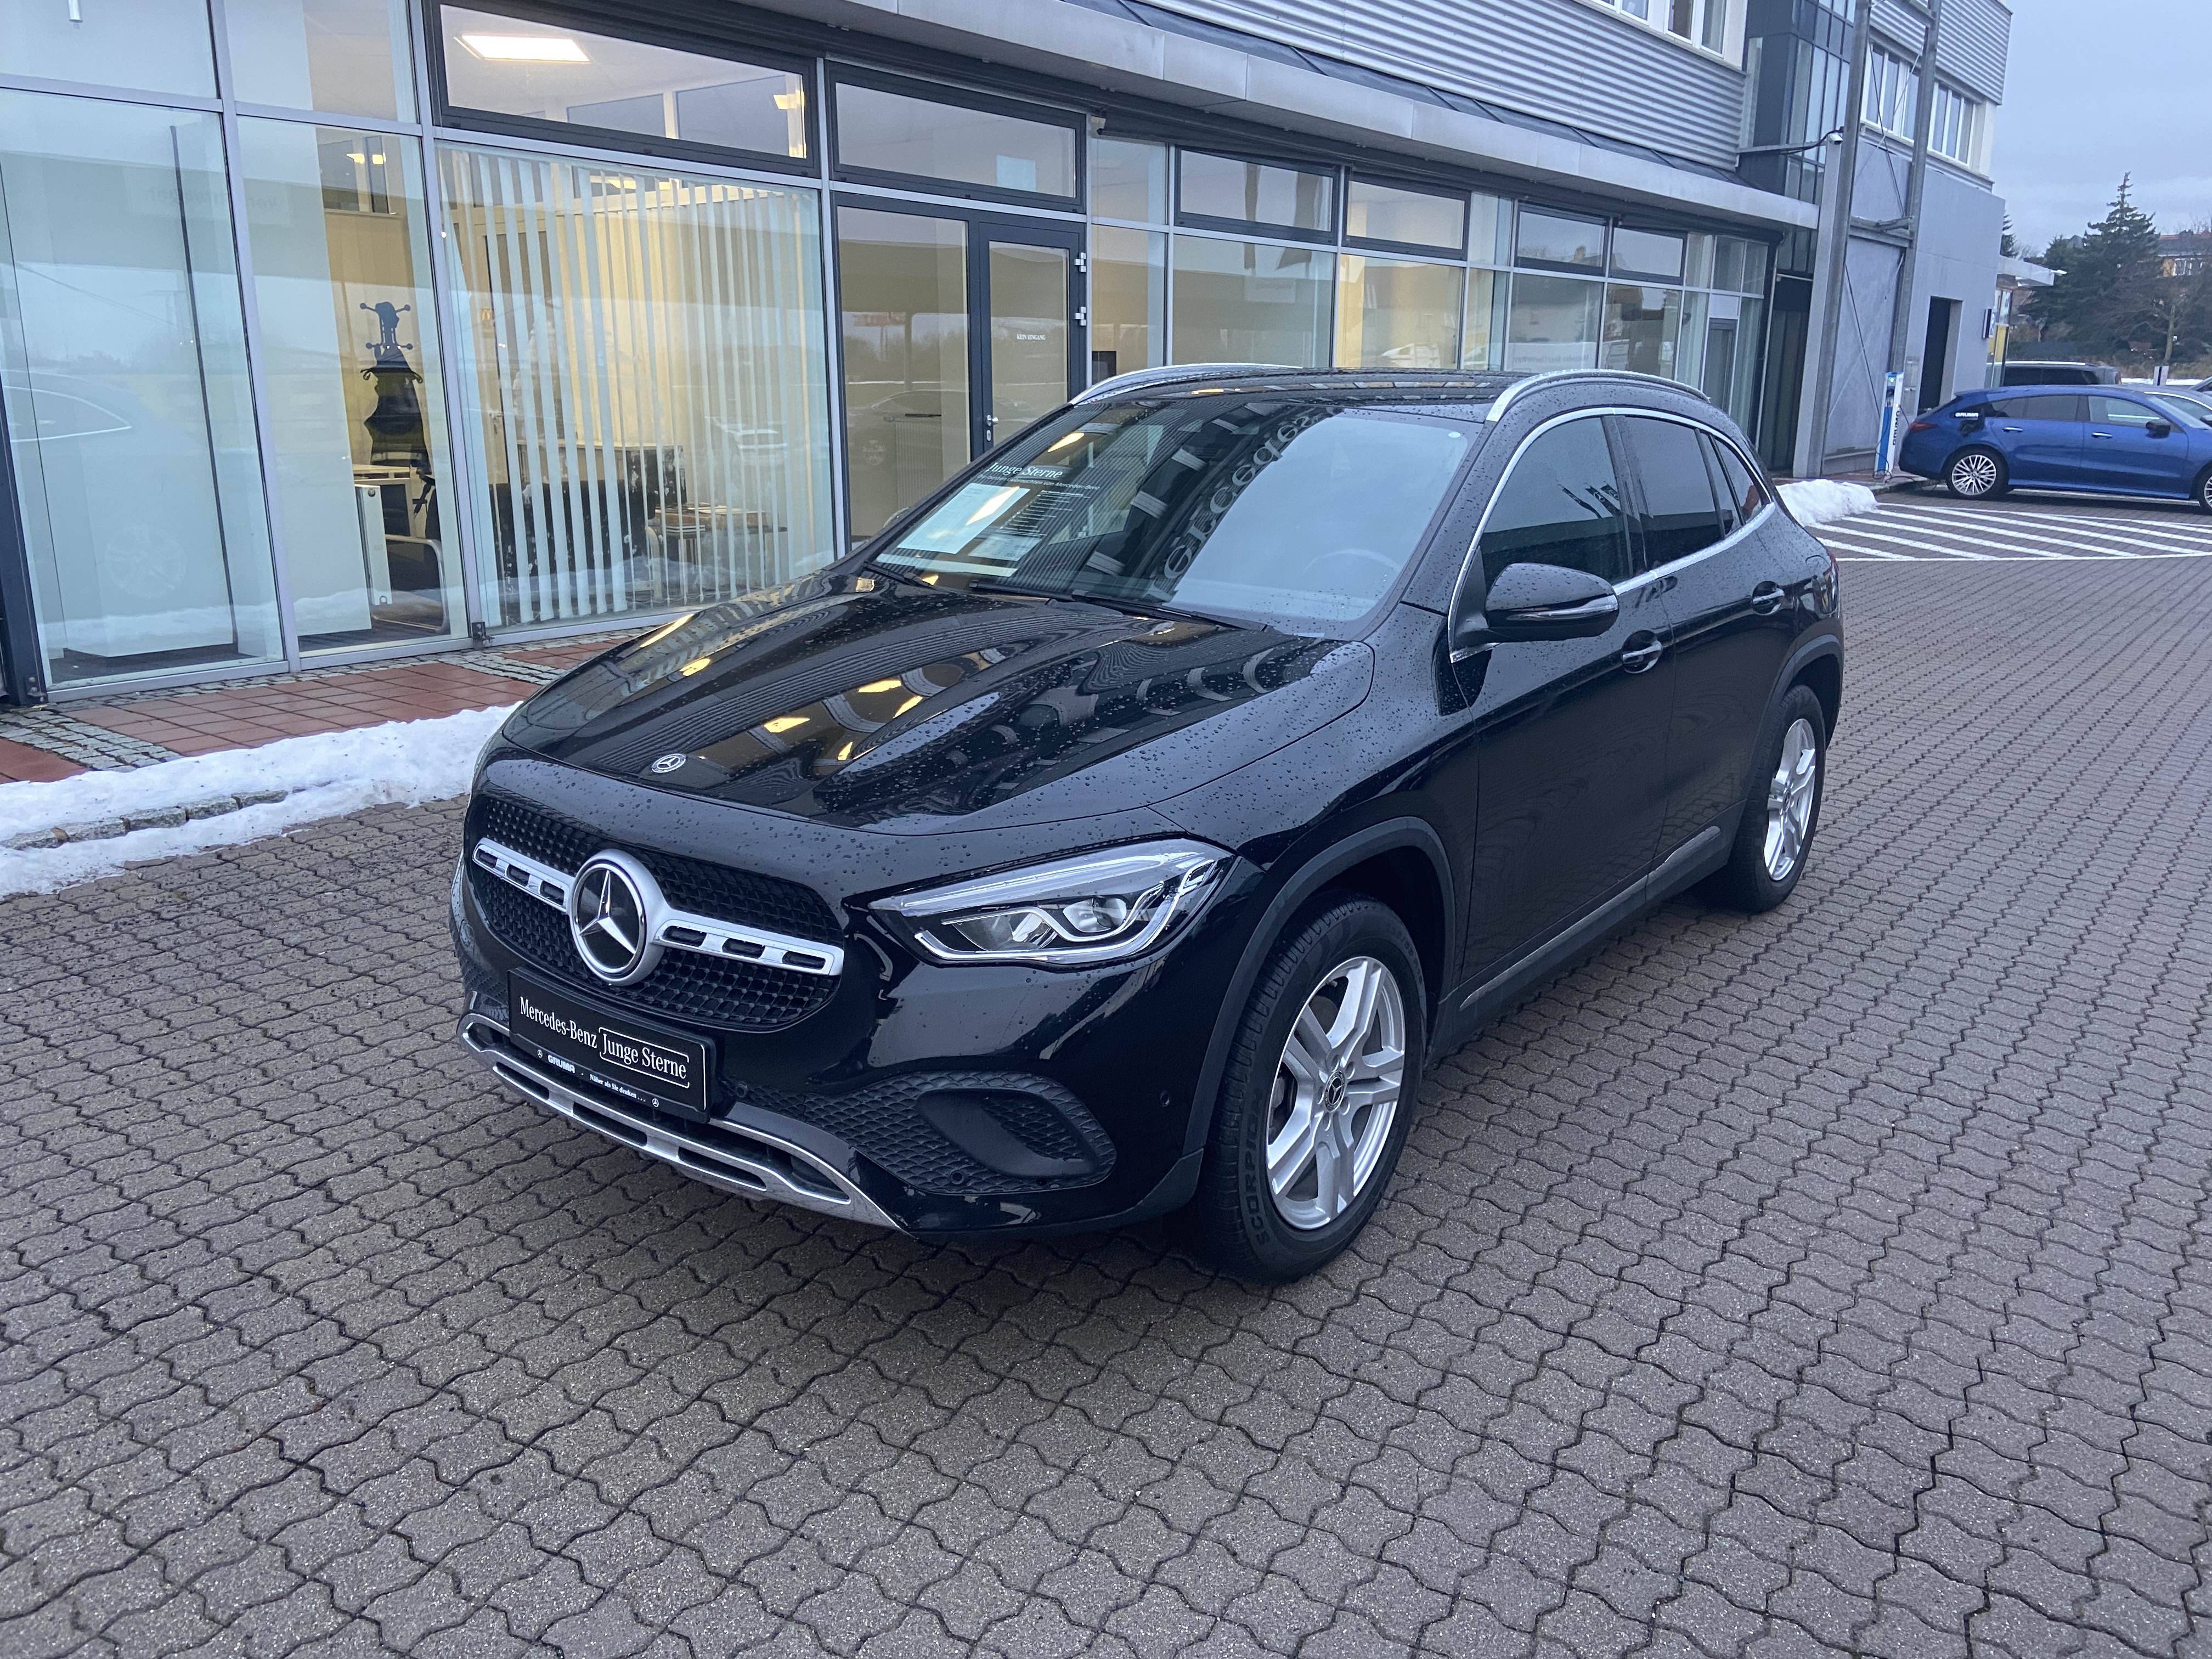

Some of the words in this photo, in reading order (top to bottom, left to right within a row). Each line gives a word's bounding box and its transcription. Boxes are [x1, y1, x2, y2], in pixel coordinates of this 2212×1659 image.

[986, 462, 1023, 475] Junge
[1022, 466, 1063, 479] Sterne
[520, 996, 598, 1049] Mercedes-Benz
[602, 1033, 639, 1065] Junge
[642, 1047, 686, 1079] Sterne
[548, 1054, 575, 1074] GRUMA
[611, 1083, 619, 1092] Sie
[619, 1086, 637, 1099] denken
